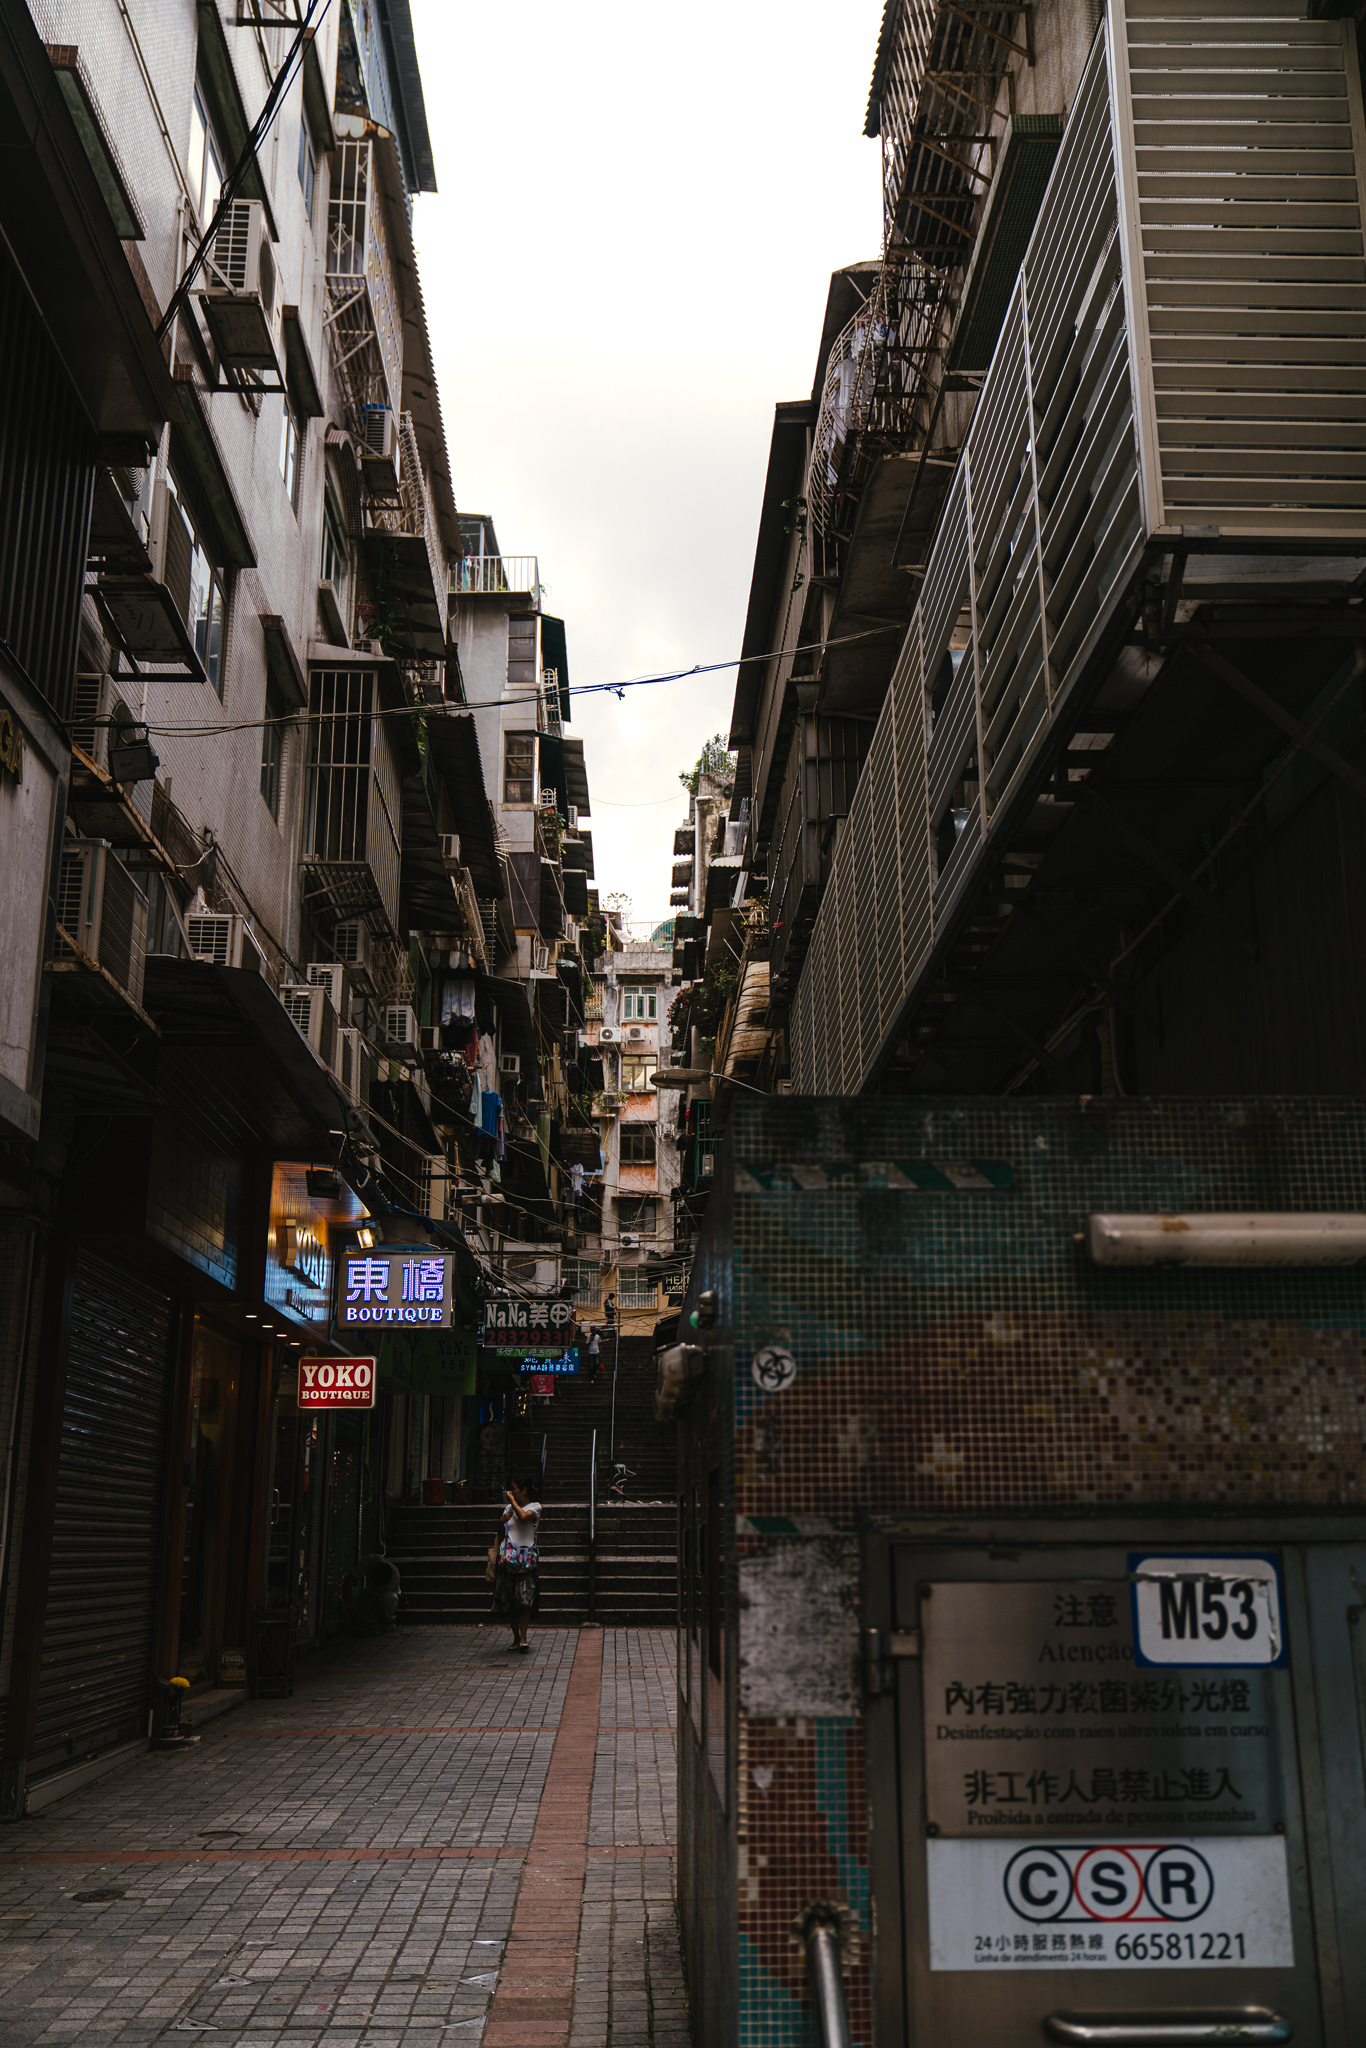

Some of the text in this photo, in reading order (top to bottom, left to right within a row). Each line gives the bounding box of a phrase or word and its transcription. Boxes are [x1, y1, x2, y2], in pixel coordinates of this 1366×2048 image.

[293, 1226, 327, 1290] YOKO
[346, 1257, 445, 1302] 東橋
[346, 1307, 443, 1323] BOUTIQUE
[486, 1330, 569, 1345] 28329331
[302, 1365, 372, 1388] YOKO
[301, 1390, 370, 1400] BOUTIQUE
[1054, 1594, 1118, 1628] 注意
[1158, 1579, 1258, 1640] M53
[1038, 1639, 1134, 1664] Atenção
[936, 1723, 1270, 1742] Desinfestação com raios ultravioleta em curso
[964, 1766, 1243, 1805] 非工作人員禁止進入
[967, 1808, 1257, 1828] Proibida a entrada de pessoas estranhas
[1019, 1861, 1198, 1907] CSR
[974, 1951, 1107, 1963] Linha de atendimento 24 horas
[1114, 1932, 1246, 1961] 66581221
